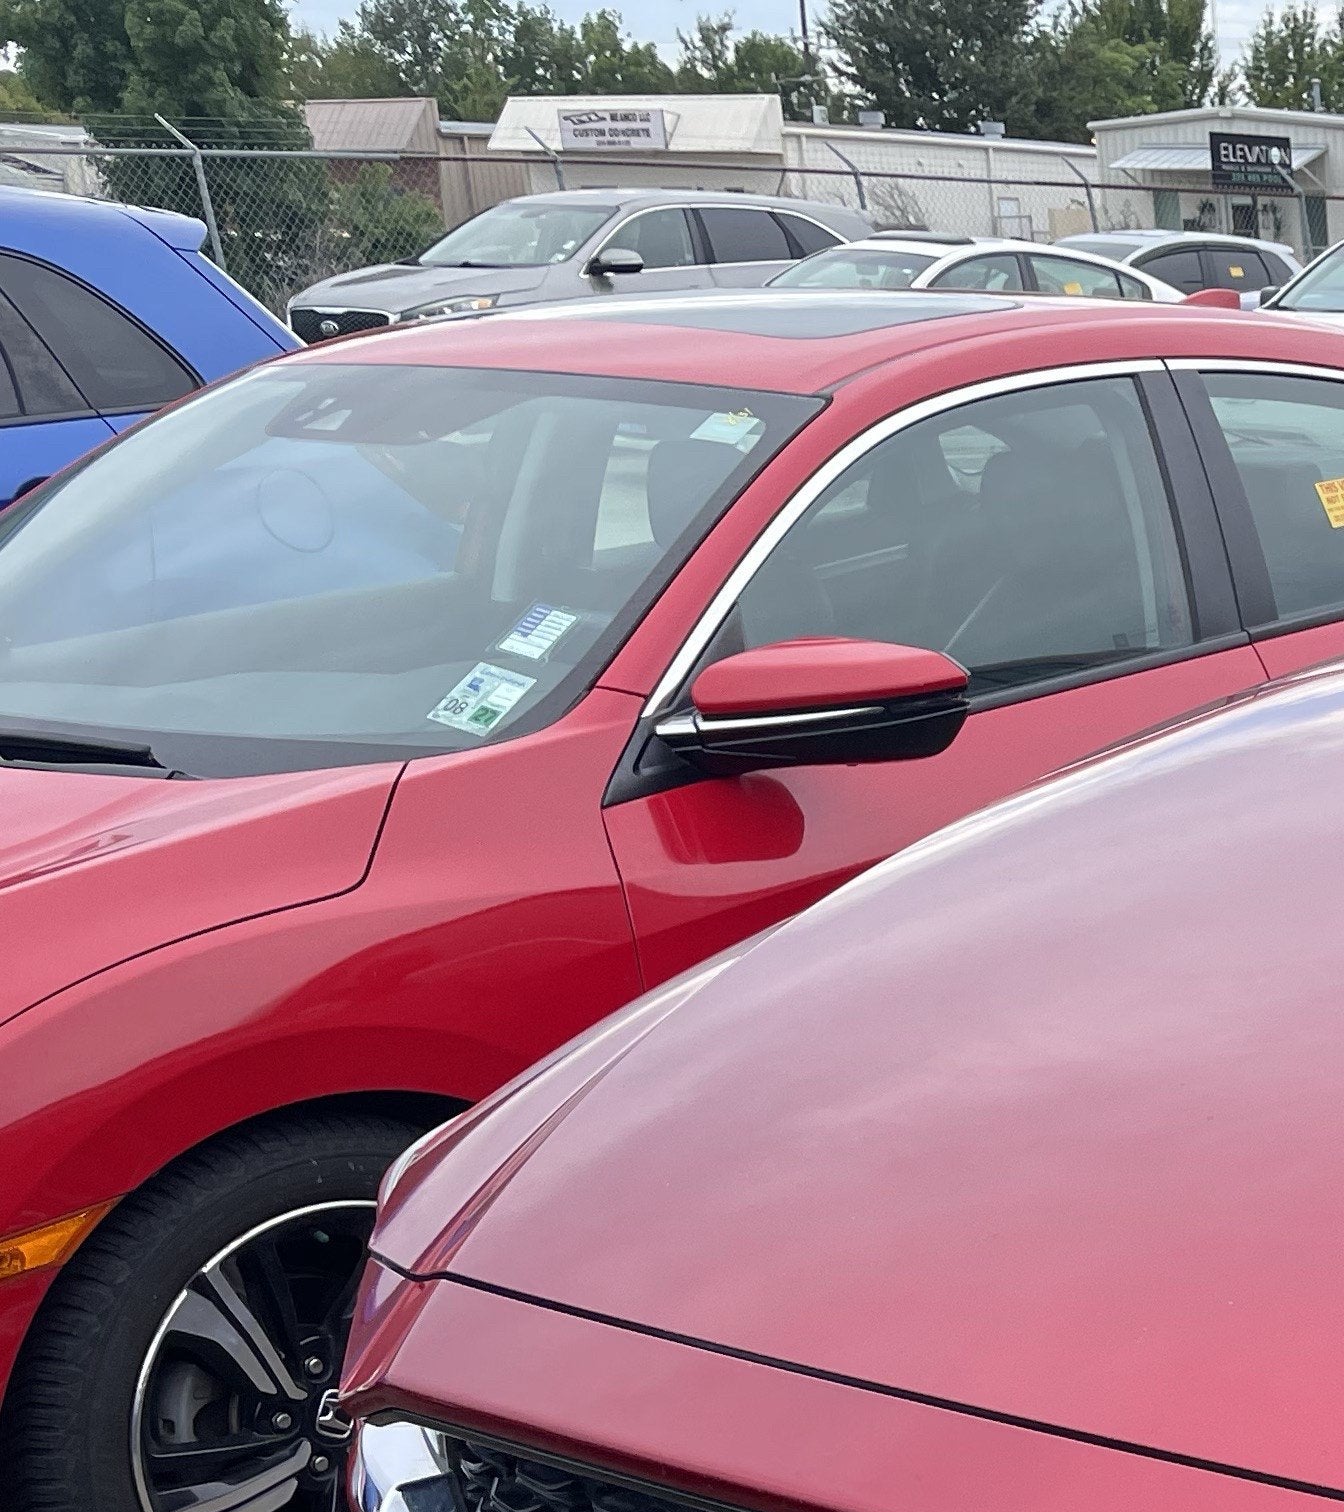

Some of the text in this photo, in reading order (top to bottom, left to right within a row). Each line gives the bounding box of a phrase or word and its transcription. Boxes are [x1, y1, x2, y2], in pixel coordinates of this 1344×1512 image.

[572, 127, 651, 138] CUSTOM CONCRETE
[443, 698, 469, 716] 08
